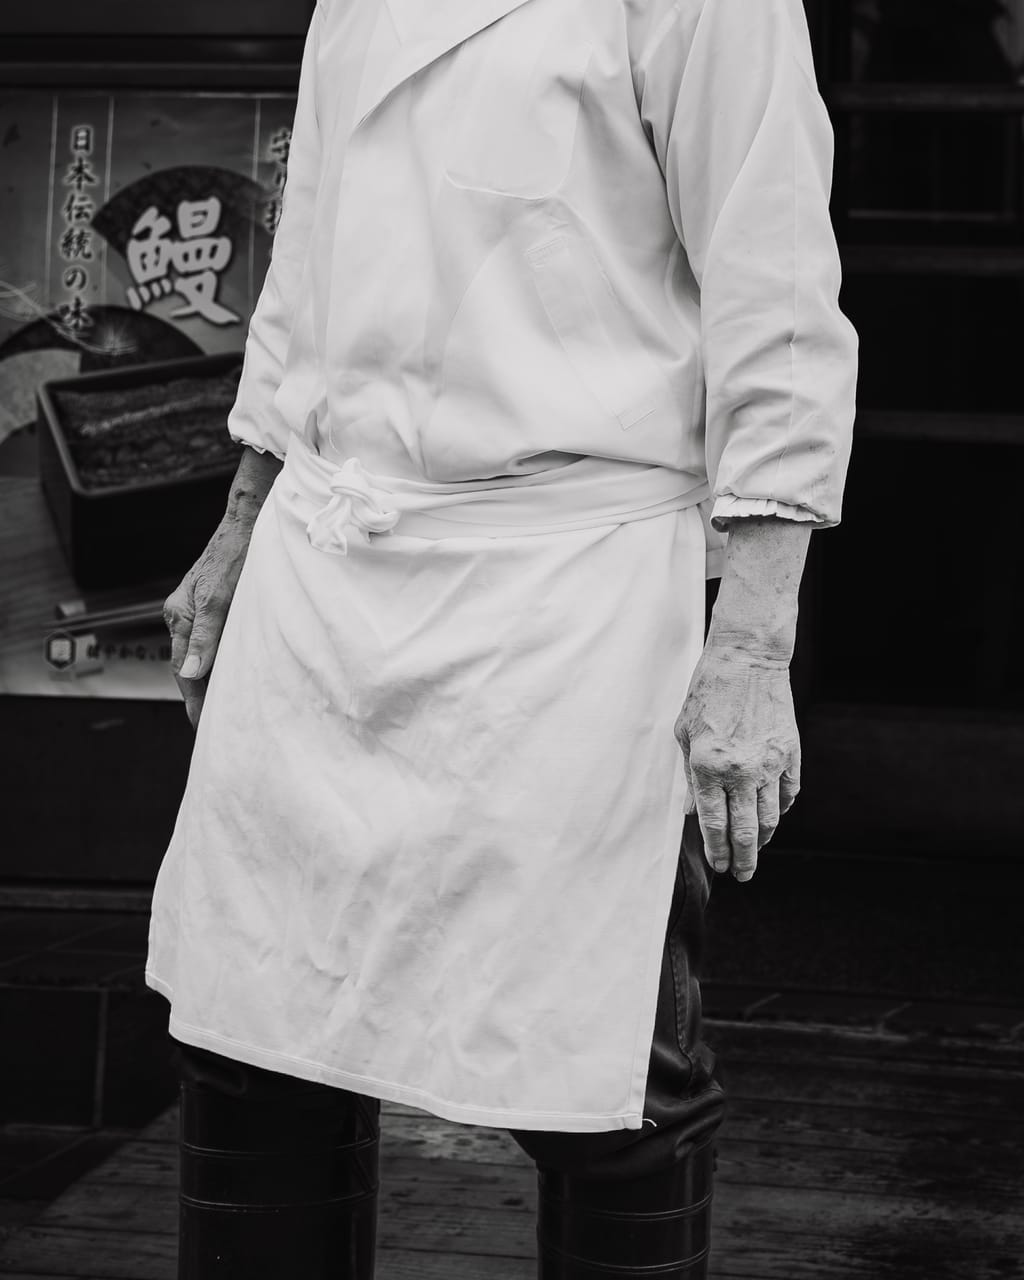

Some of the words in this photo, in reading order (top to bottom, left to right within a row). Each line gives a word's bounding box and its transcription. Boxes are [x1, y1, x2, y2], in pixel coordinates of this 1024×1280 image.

[60, 126, 96, 330] 日本伝統の味
[126, 195, 241, 325] 鰻
